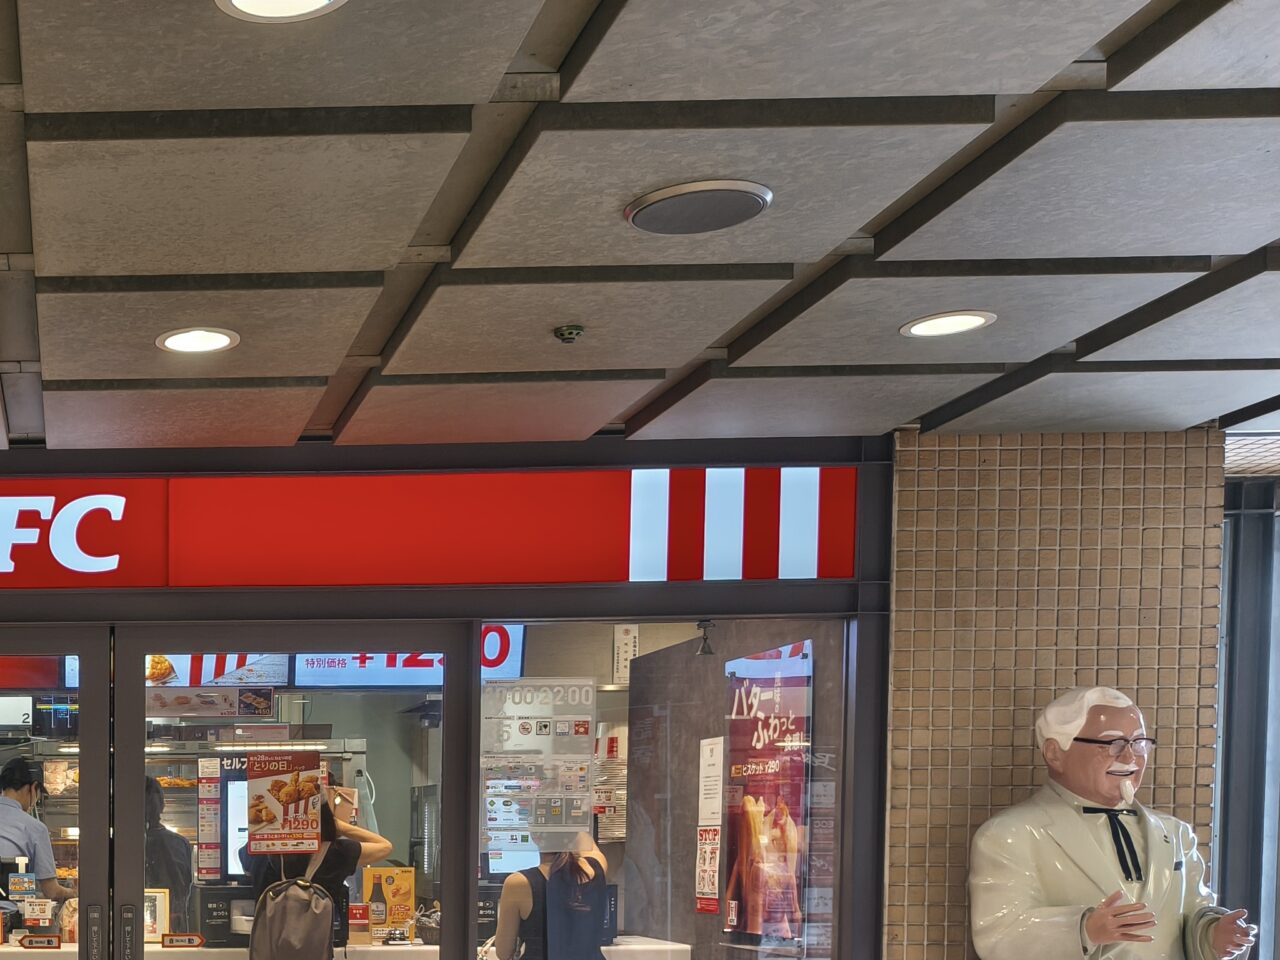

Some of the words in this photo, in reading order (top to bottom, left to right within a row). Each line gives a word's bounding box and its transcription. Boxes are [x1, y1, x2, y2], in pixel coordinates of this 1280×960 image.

[305, 658, 348, 669] 特別価格
[732, 679, 774, 719] バター
[22, 712, 31, 724] 2
[751, 710, 796, 749] ふわっと
[698, 827, 721, 843] STOP!
